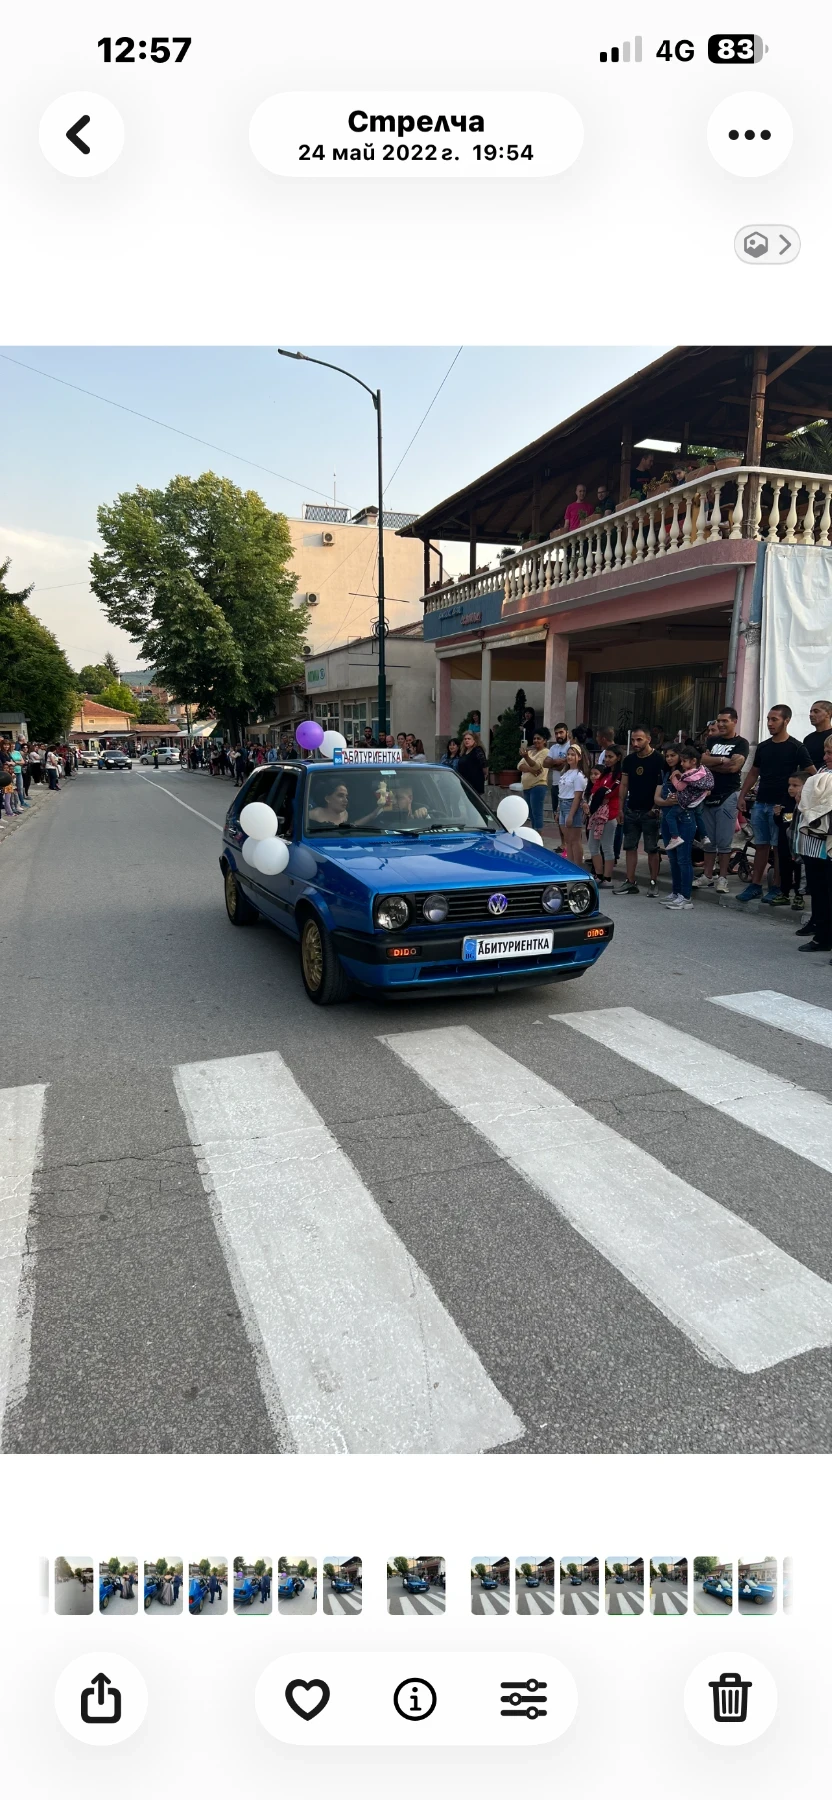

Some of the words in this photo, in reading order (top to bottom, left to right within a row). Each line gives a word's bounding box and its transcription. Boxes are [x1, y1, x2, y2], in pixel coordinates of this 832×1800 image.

[343, 750, 402, 764] АБИТУРИЕНТКА
[587, 929, 604, 938] DIDO
[477, 938, 550, 955] АБИТУРИЕНТКА
[393, 948, 417, 957] DIDO
